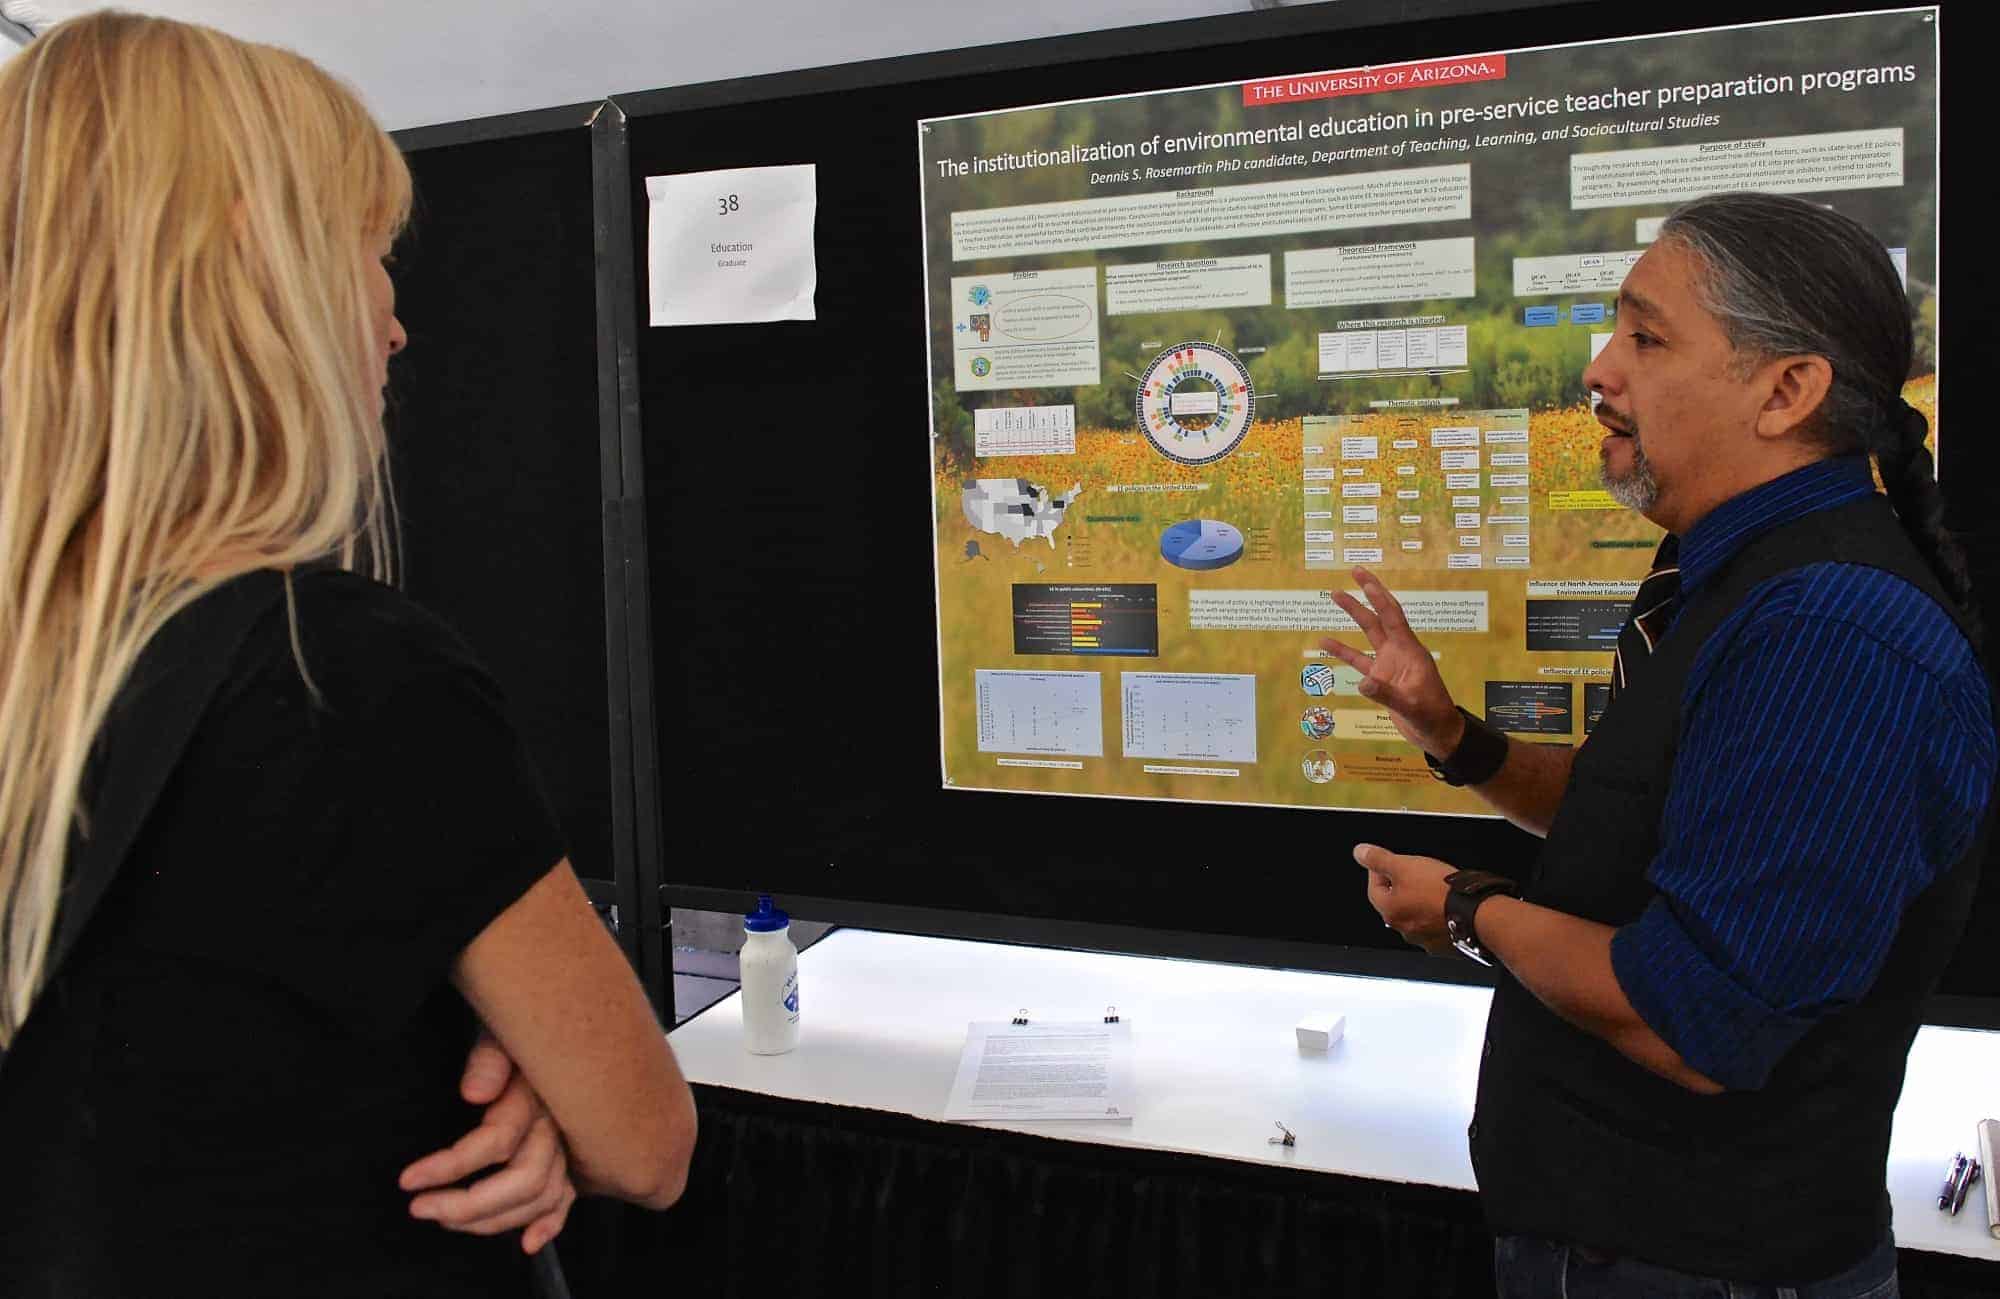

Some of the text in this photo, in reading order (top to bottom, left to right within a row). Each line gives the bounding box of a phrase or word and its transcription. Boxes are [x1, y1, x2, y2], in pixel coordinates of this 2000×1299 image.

[1253, 86, 1284, 100] THE
[1289, 74, 1379, 97] UNIVERSITY
[1384, 72, 1406, 85] OF
[937, 64, 1915, 178] The institutionalization of environmental education in pre-service teacher preparation programs
[1091, 113, 1720, 185] Dennis S. Rosemartin PhD candidate, Department of Teaching, Learning, and Sociocultural Studies
[1700, 144, 1731, 152] Purpose
[1176, 189, 1214, 199] Background
[719, 194, 739, 216] 38
[711, 242, 753, 253] Education
[718, 259, 747, 267] Graduate
[1013, 271, 1038, 280] Problem
